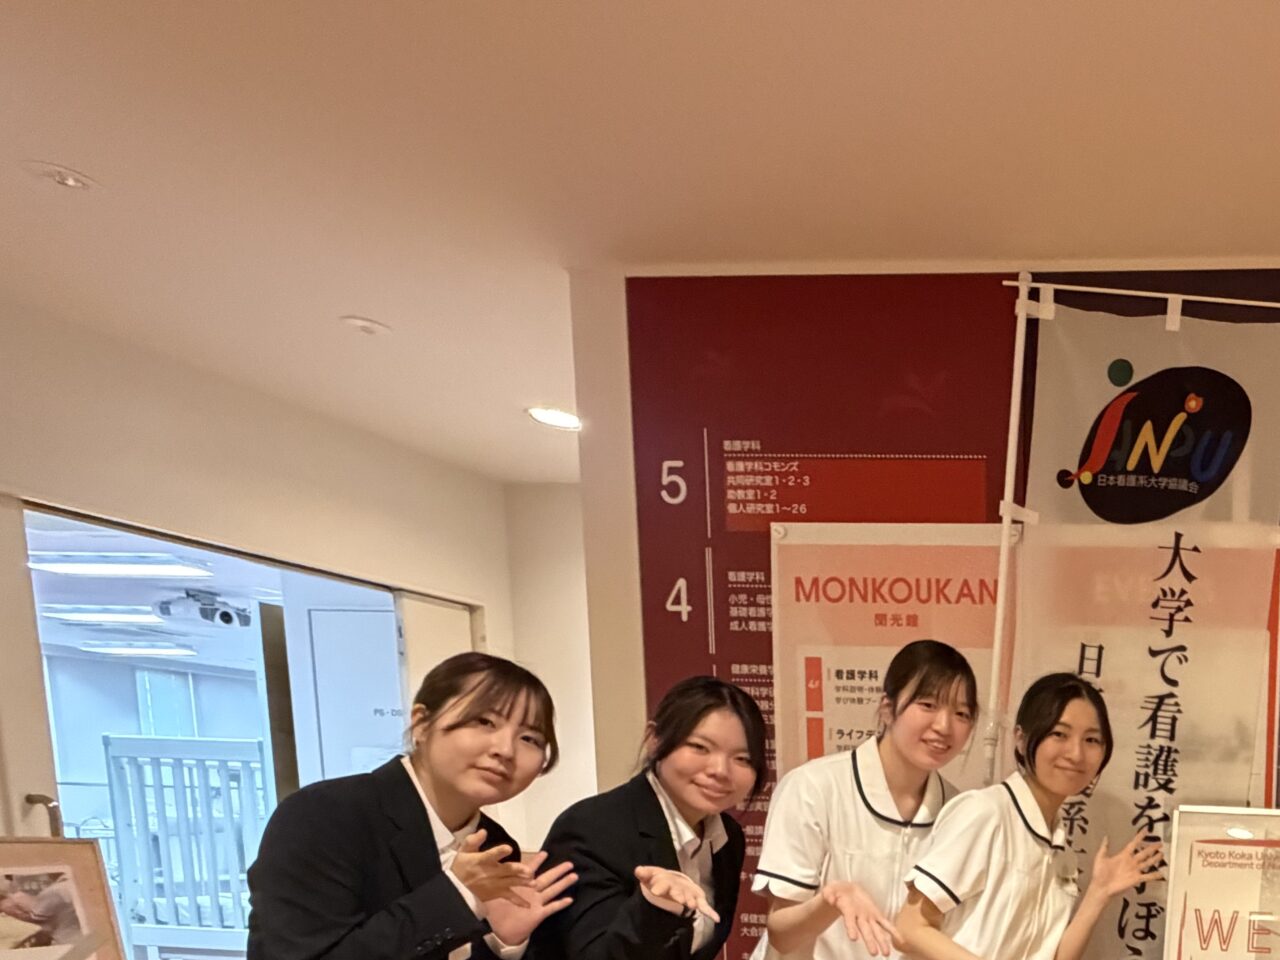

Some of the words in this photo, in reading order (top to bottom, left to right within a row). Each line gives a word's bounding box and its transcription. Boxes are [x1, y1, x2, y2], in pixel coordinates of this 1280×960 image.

[660, 460, 688, 505] 5
[665, 577, 693, 622] 4
[794, 576, 998, 605] MONKOUKAN
[835, 669, 879, 681] 看護学科
[1197, 850, 1226, 859] Kyoto
[1228, 850, 1253, 860] Koka
